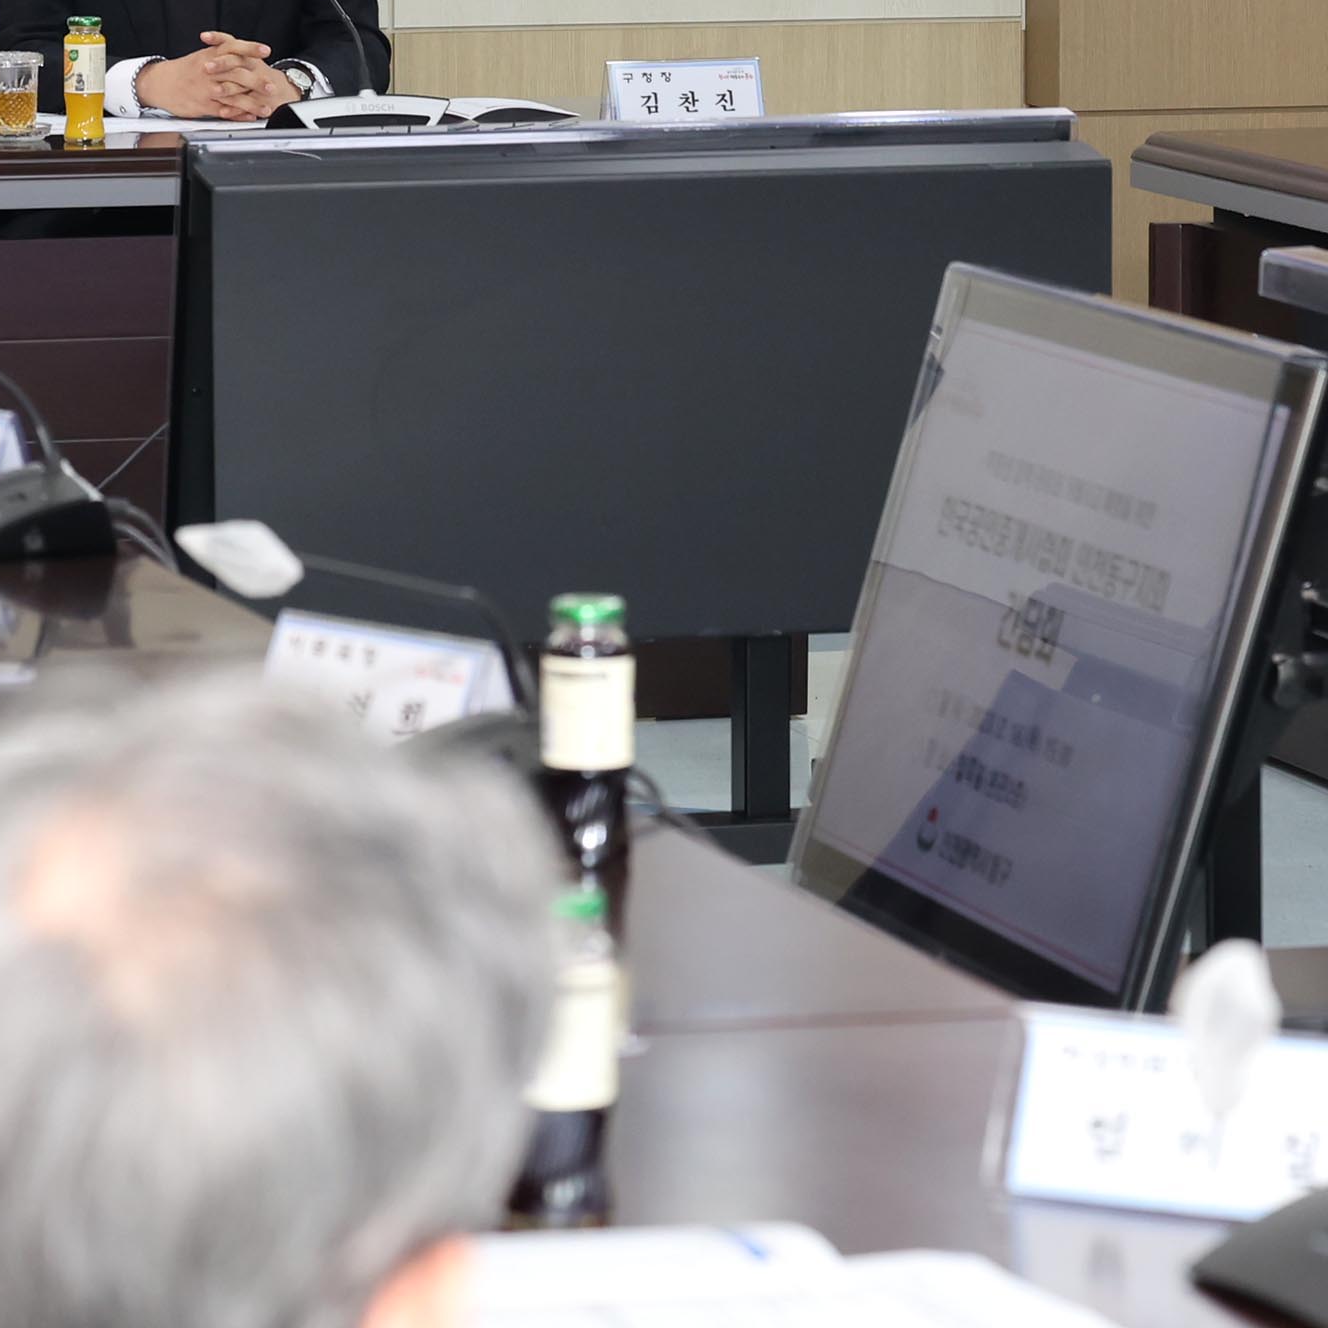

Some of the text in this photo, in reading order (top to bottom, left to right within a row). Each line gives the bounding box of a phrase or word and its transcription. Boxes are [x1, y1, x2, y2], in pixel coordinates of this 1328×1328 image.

[623, 72, 672, 84] 구청장
[360, 103, 395, 112] BOSCH
[640, 89, 737, 115] 김찬진
